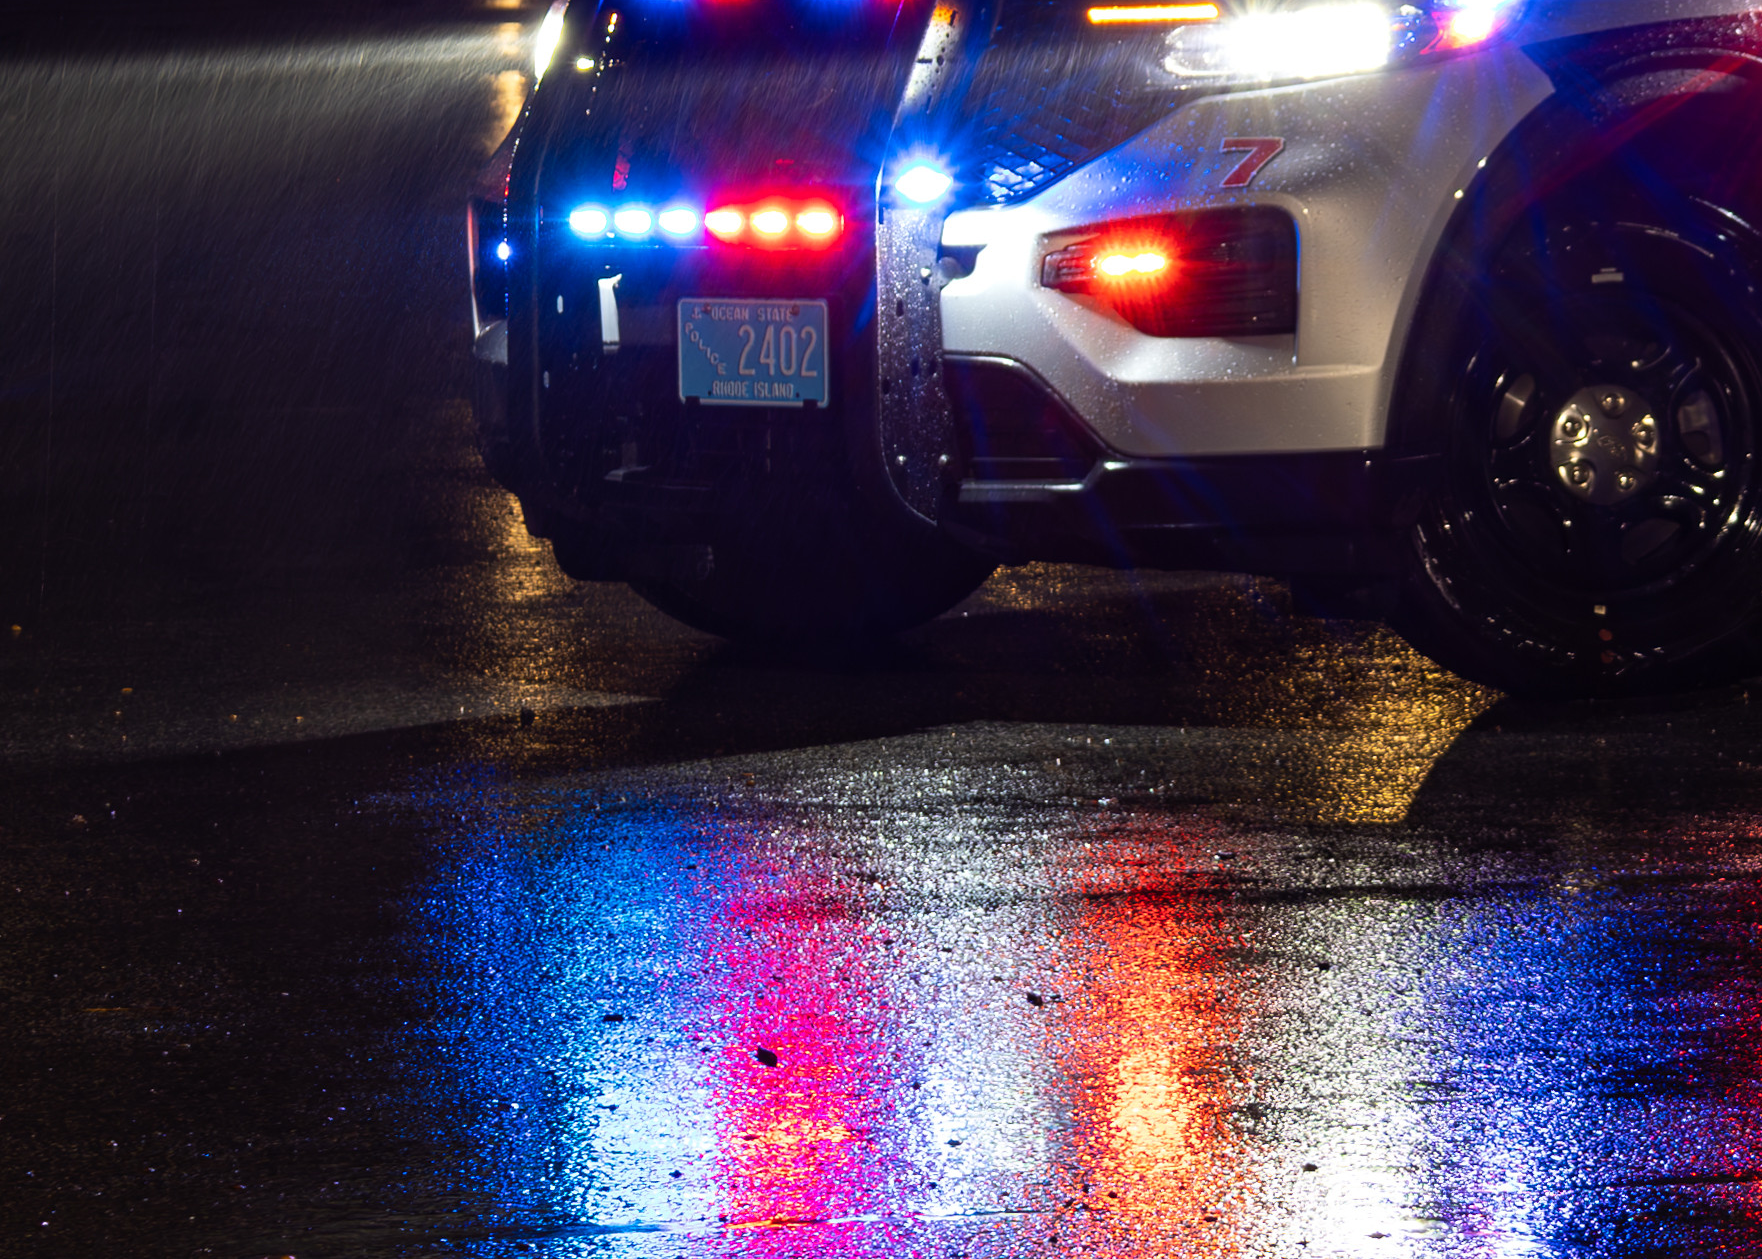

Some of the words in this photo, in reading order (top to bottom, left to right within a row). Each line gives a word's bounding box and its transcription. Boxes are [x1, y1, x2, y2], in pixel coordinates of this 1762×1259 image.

[1220, 136, 1285, 188] 7
[711, 306, 749, 321] OCEAN
[757, 306, 794, 322] STATE
[684, 322, 727, 376] POLICE
[737, 323, 818, 377] 2402
[711, 380, 749, 398] RHODE
[753, 381, 795, 399] ISLAND
